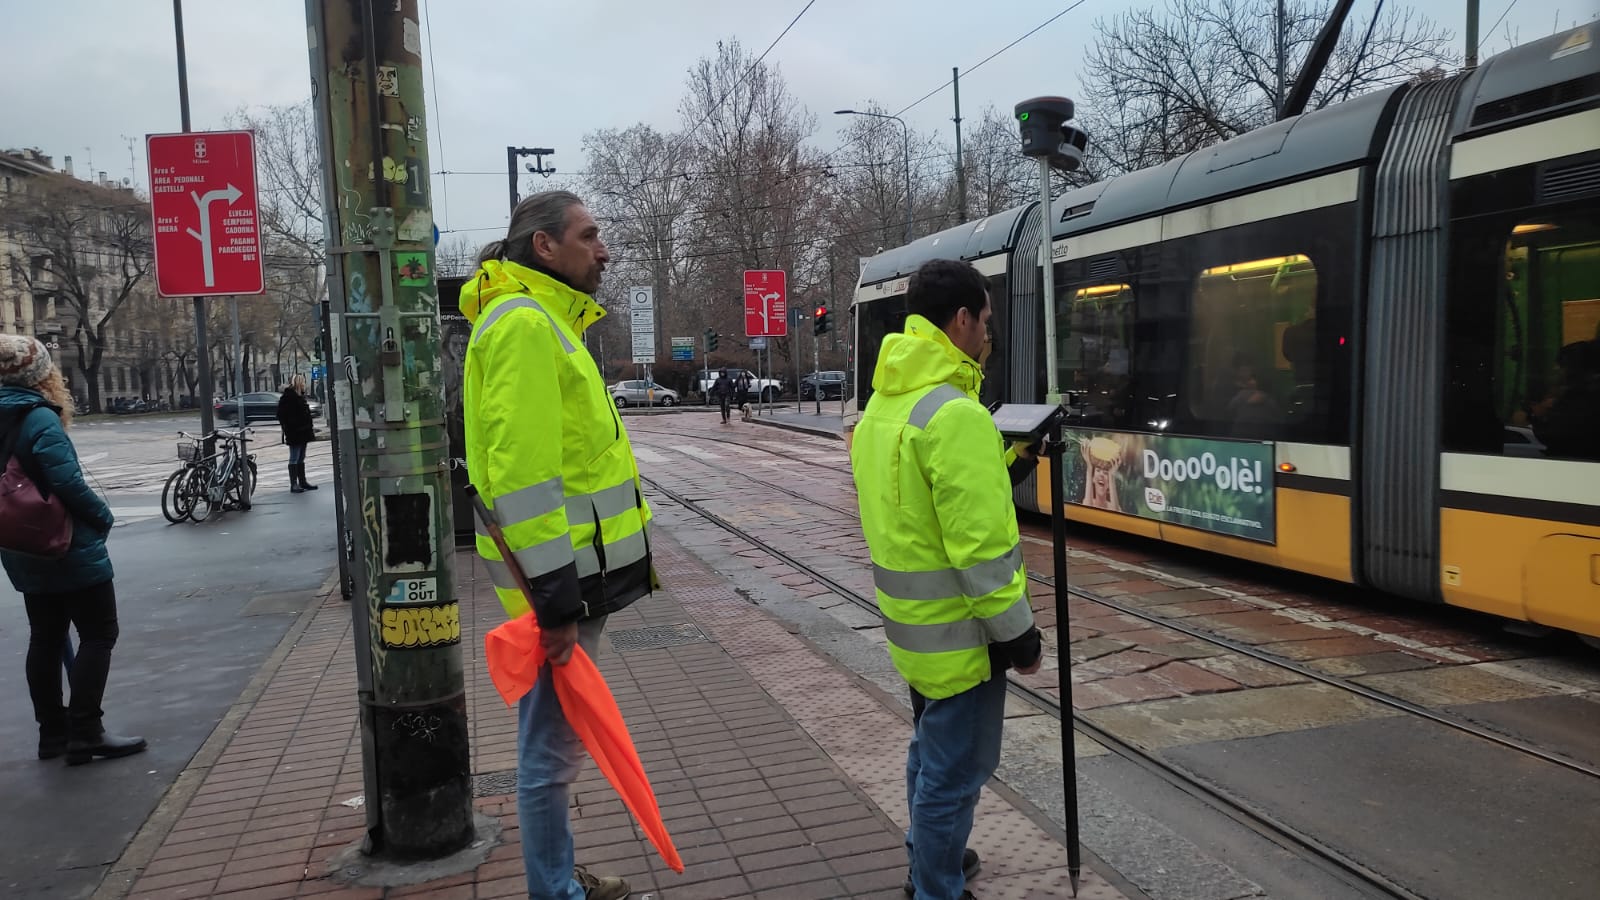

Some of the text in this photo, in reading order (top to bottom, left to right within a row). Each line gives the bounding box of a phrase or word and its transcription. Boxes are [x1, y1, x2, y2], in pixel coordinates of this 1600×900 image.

[154, 175, 205, 184] AREA PEDONALE
[154, 185, 185, 193] CASTELLO
[228, 209, 253, 217] ELVEZIA
[223, 218, 254, 226] SEMPIONE
[157, 225, 178, 233] BRERA
[225, 226, 255, 234] CADORNA
[230, 237, 256, 246] PAGANO
[218, 245, 257, 254] PARCHEGGIO
[242, 253, 256, 261] BUS
[408, 581, 427, 590] OF
[408, 591, 434, 600] OUT
